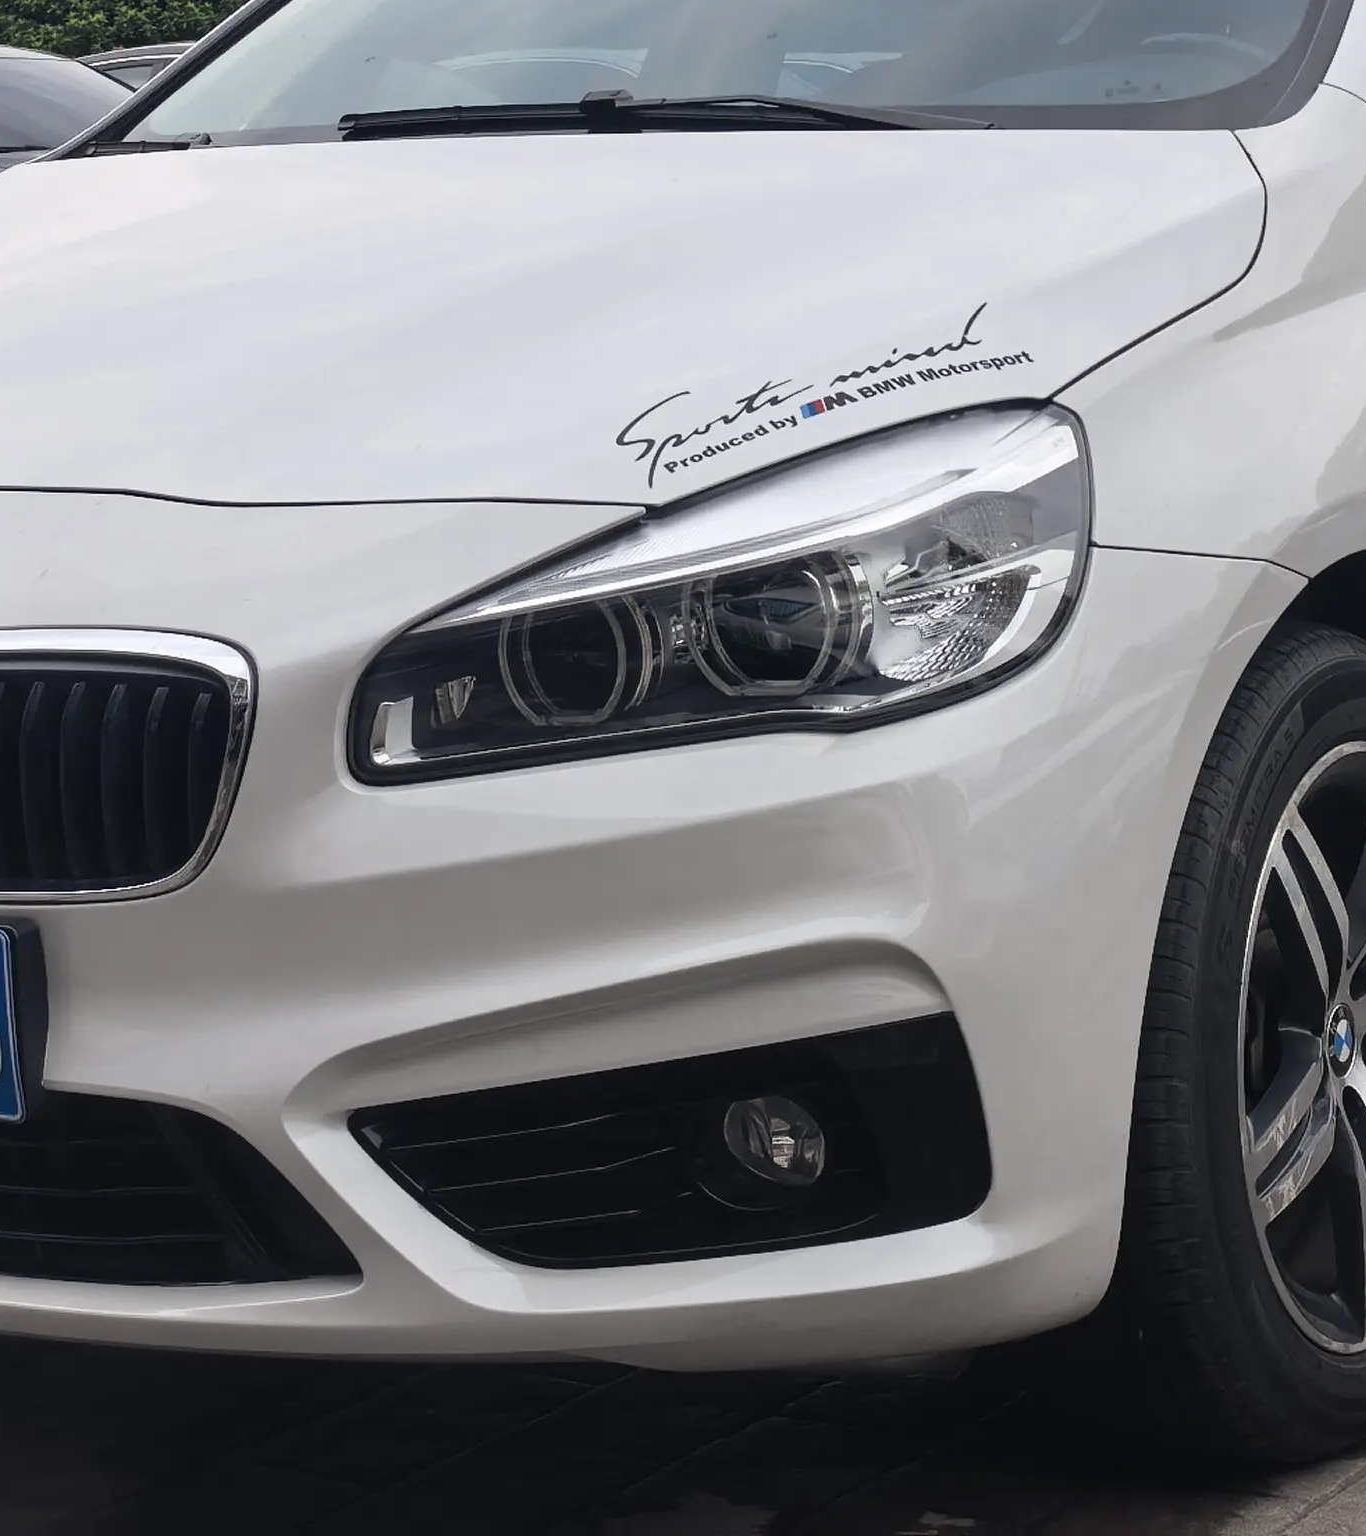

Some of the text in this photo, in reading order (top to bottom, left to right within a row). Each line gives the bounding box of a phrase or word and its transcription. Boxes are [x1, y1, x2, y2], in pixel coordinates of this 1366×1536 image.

[663, 424, 771, 475] Produced
[773, 413, 799, 434] by
[860, 372, 917, 399] BMW
[921, 350, 1035, 383] Motorsport
